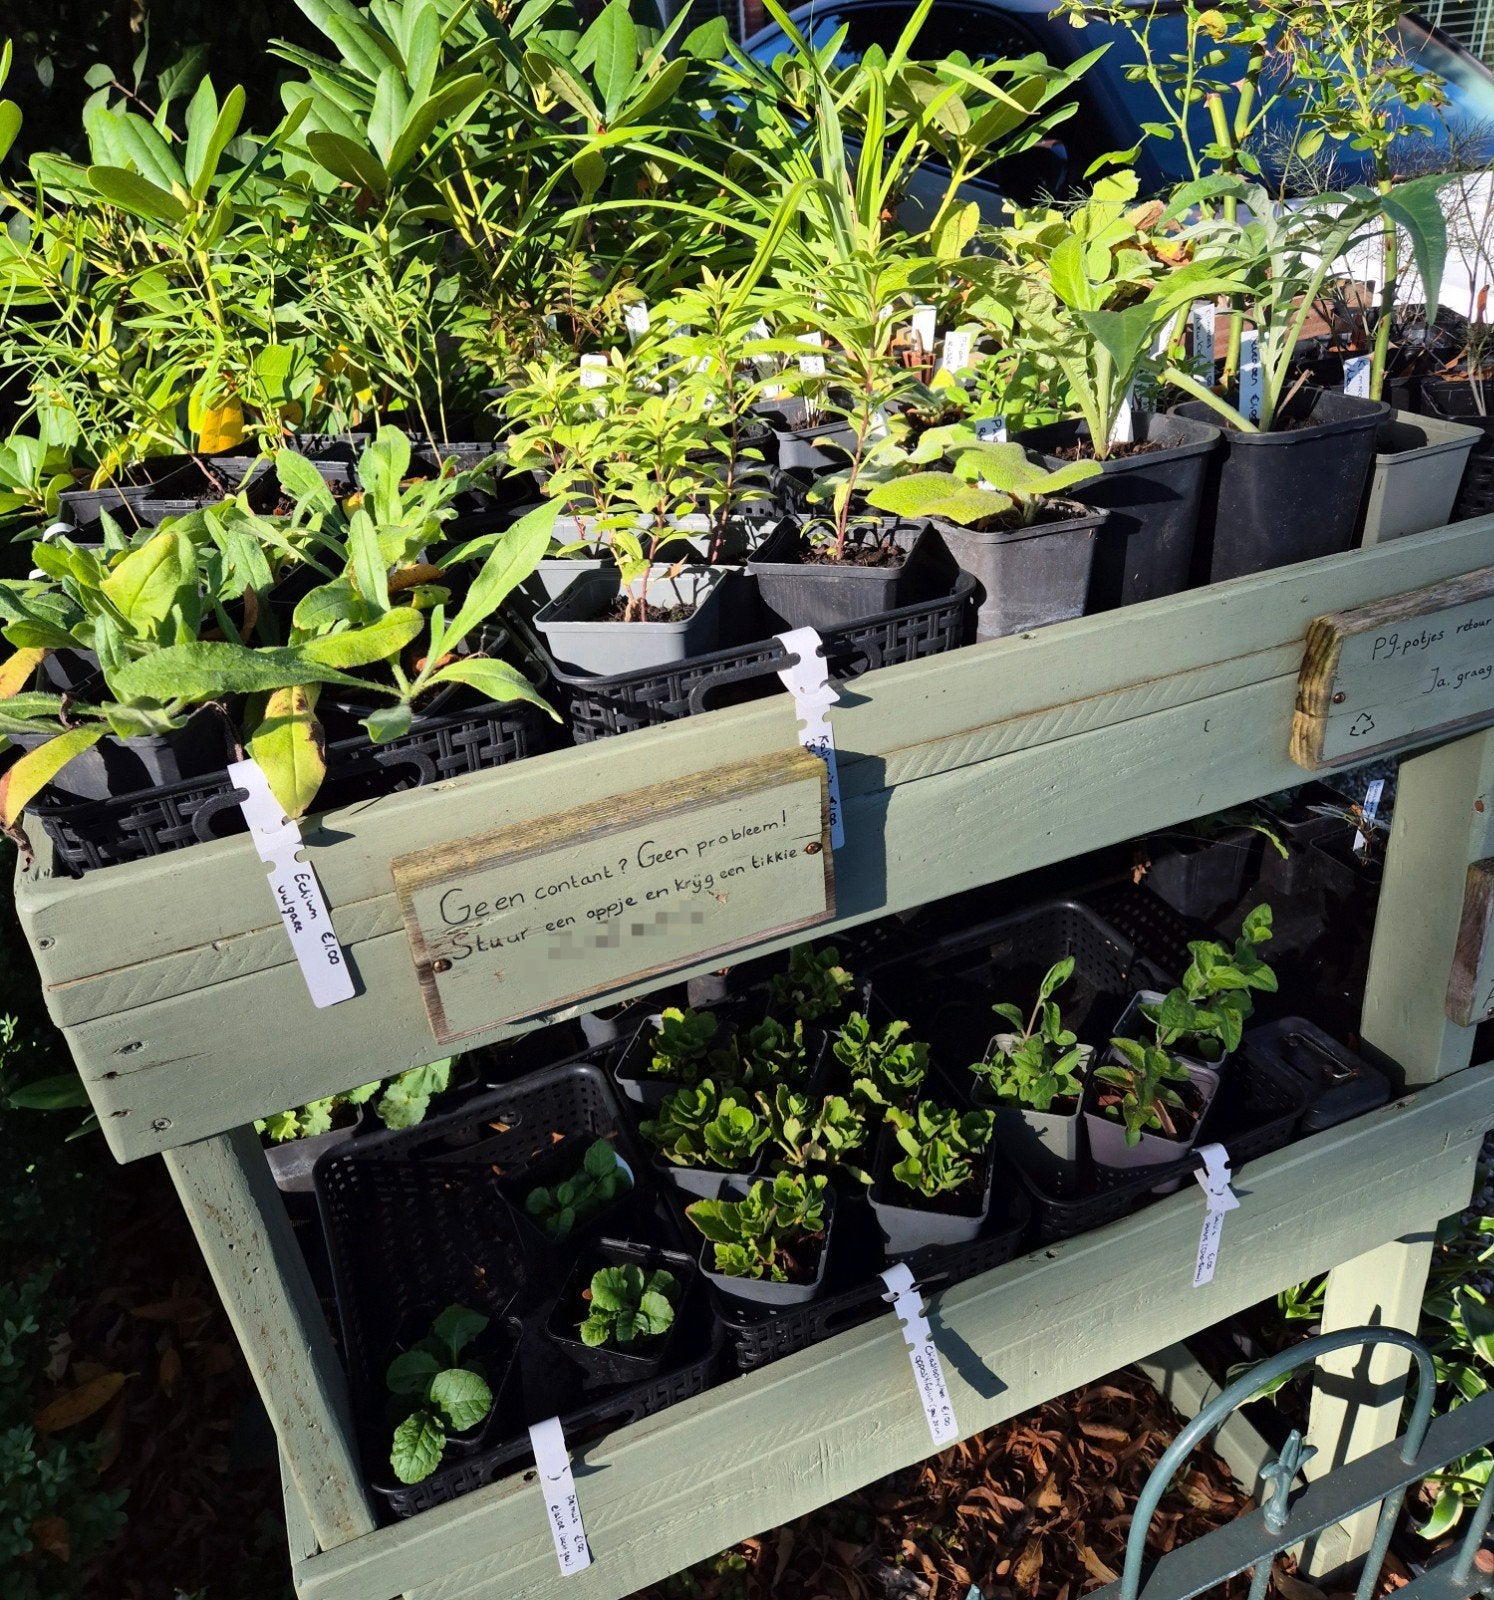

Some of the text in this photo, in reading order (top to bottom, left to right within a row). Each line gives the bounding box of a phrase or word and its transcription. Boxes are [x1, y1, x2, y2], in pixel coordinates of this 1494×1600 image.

[1456, 617, 1492, 634] retour
[1453, 665, 1493, 690] graag
[440, 888, 525, 926] Geen
[637, 840, 689, 868] Geen
[697, 809, 787, 858] probleem!
[277, 884, 303, 934] vulgare
[452, 927, 529, 960] Stuur
[545, 916, 576, 932] een
[586, 896, 639, 919] appje
[645, 887, 669, 901] en
[719, 865, 745, 880] een
[751, 848, 798, 869] tikkie
